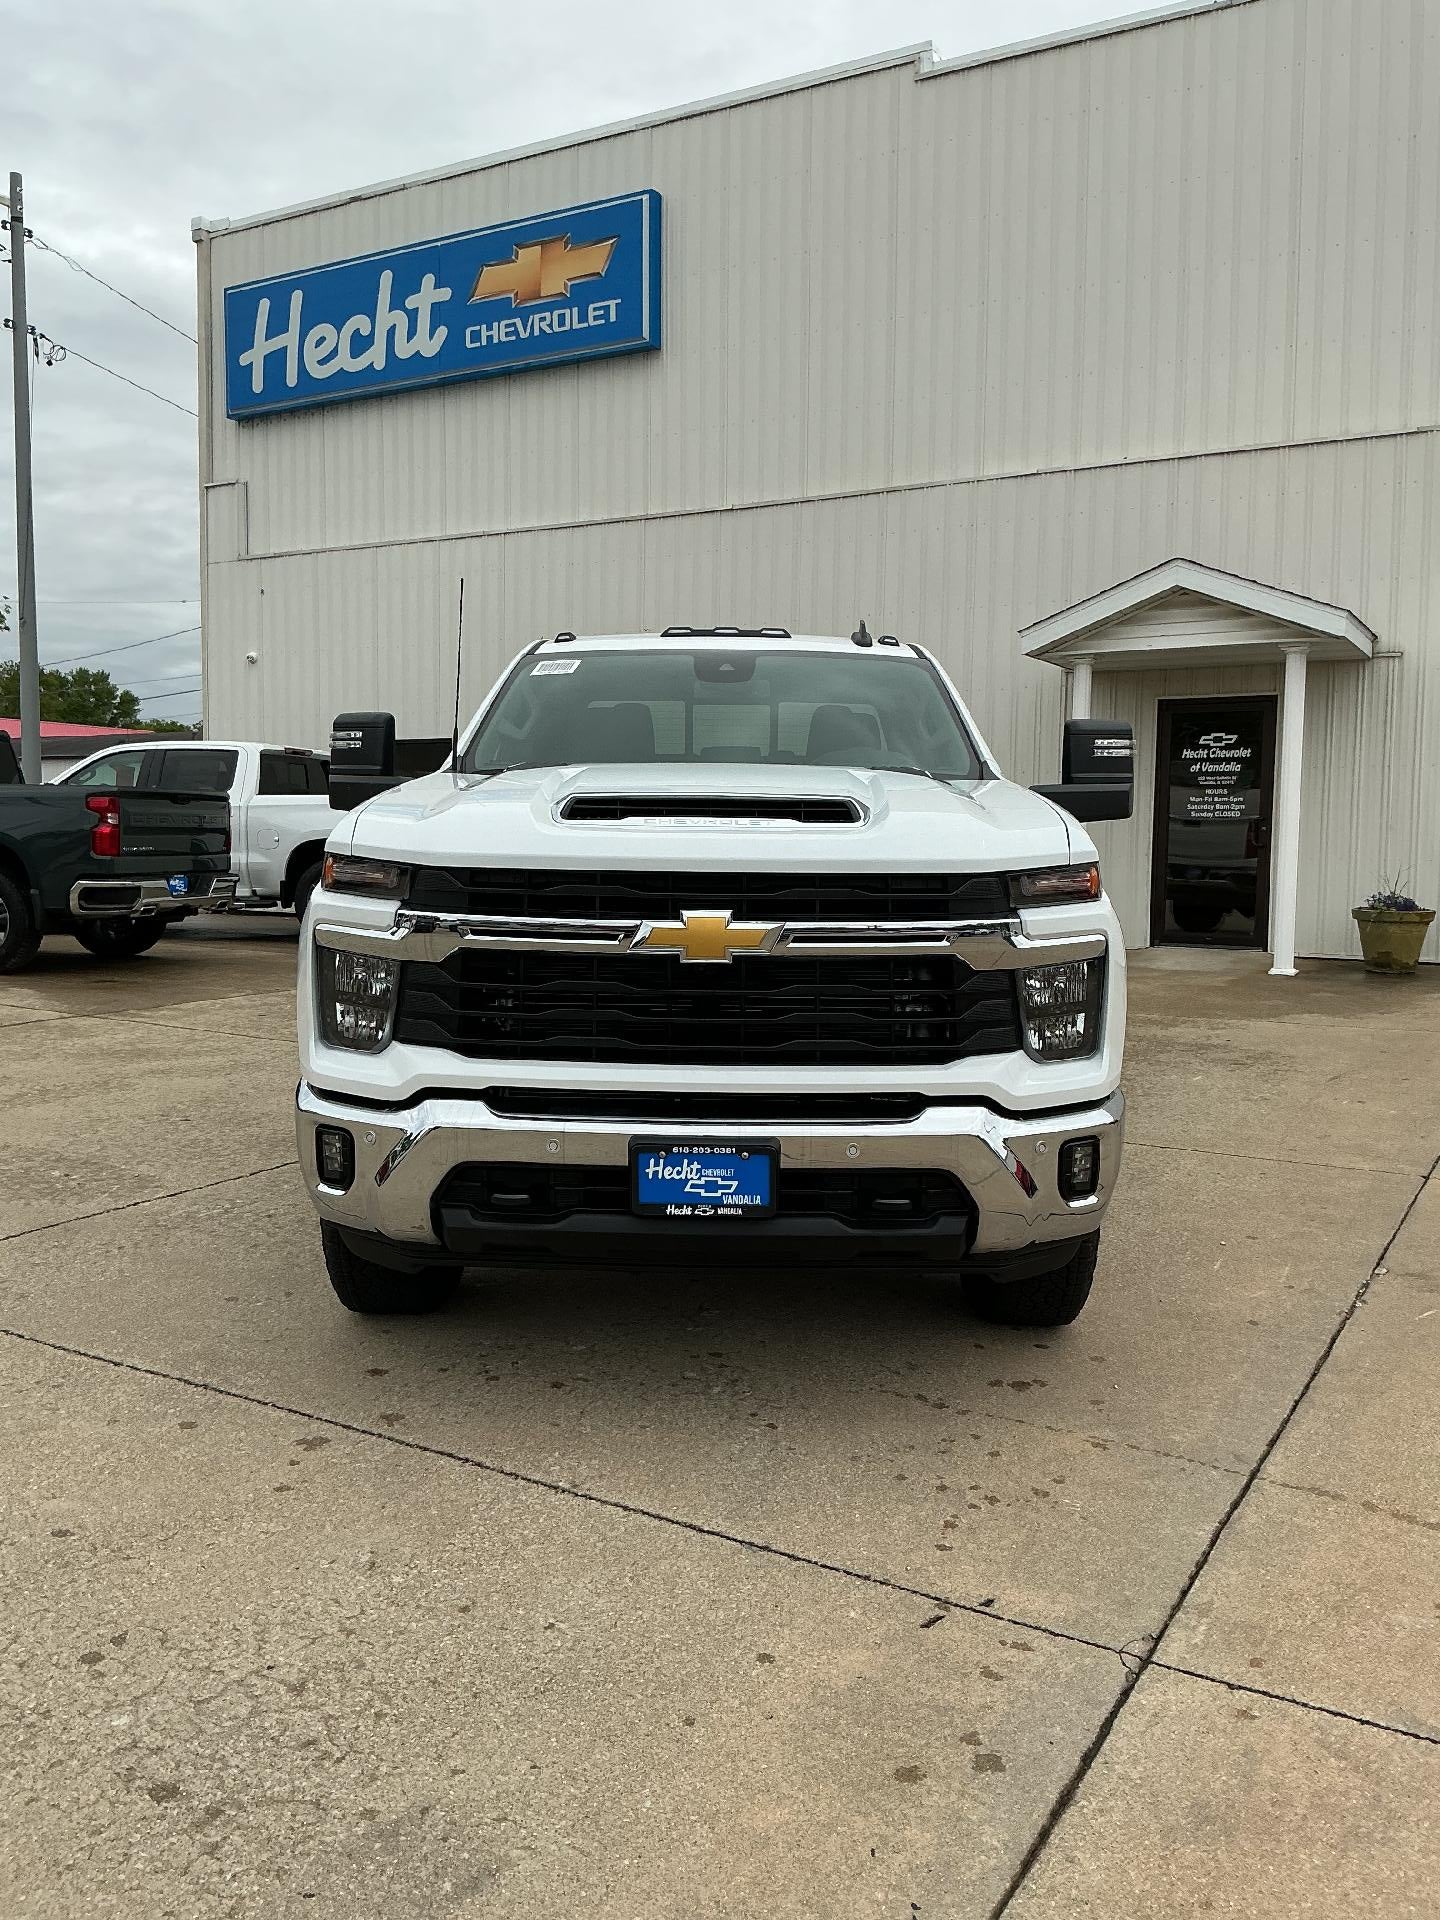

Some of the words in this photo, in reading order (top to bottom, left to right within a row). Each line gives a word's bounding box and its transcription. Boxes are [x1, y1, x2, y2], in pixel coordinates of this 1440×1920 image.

[465, 298, 622, 350] CHEVROLET
[239, 269, 452, 394] Hecht
[1182, 749, 1208, 758] Hecht
[1210, 747, 1251, 757] Chevrolet
[1190, 762, 1200, 772] of
[1202, 762, 1241, 771] Vandalia
[643, 818, 777, 826] CHEVROLET
[645, 1157, 702, 1180] Hecht
[701, 1168, 735, 1177] CHEVROLET
[722, 1194, 761, 1205] VANDALIA
[665, 1204, 693, 1216] Hecht
